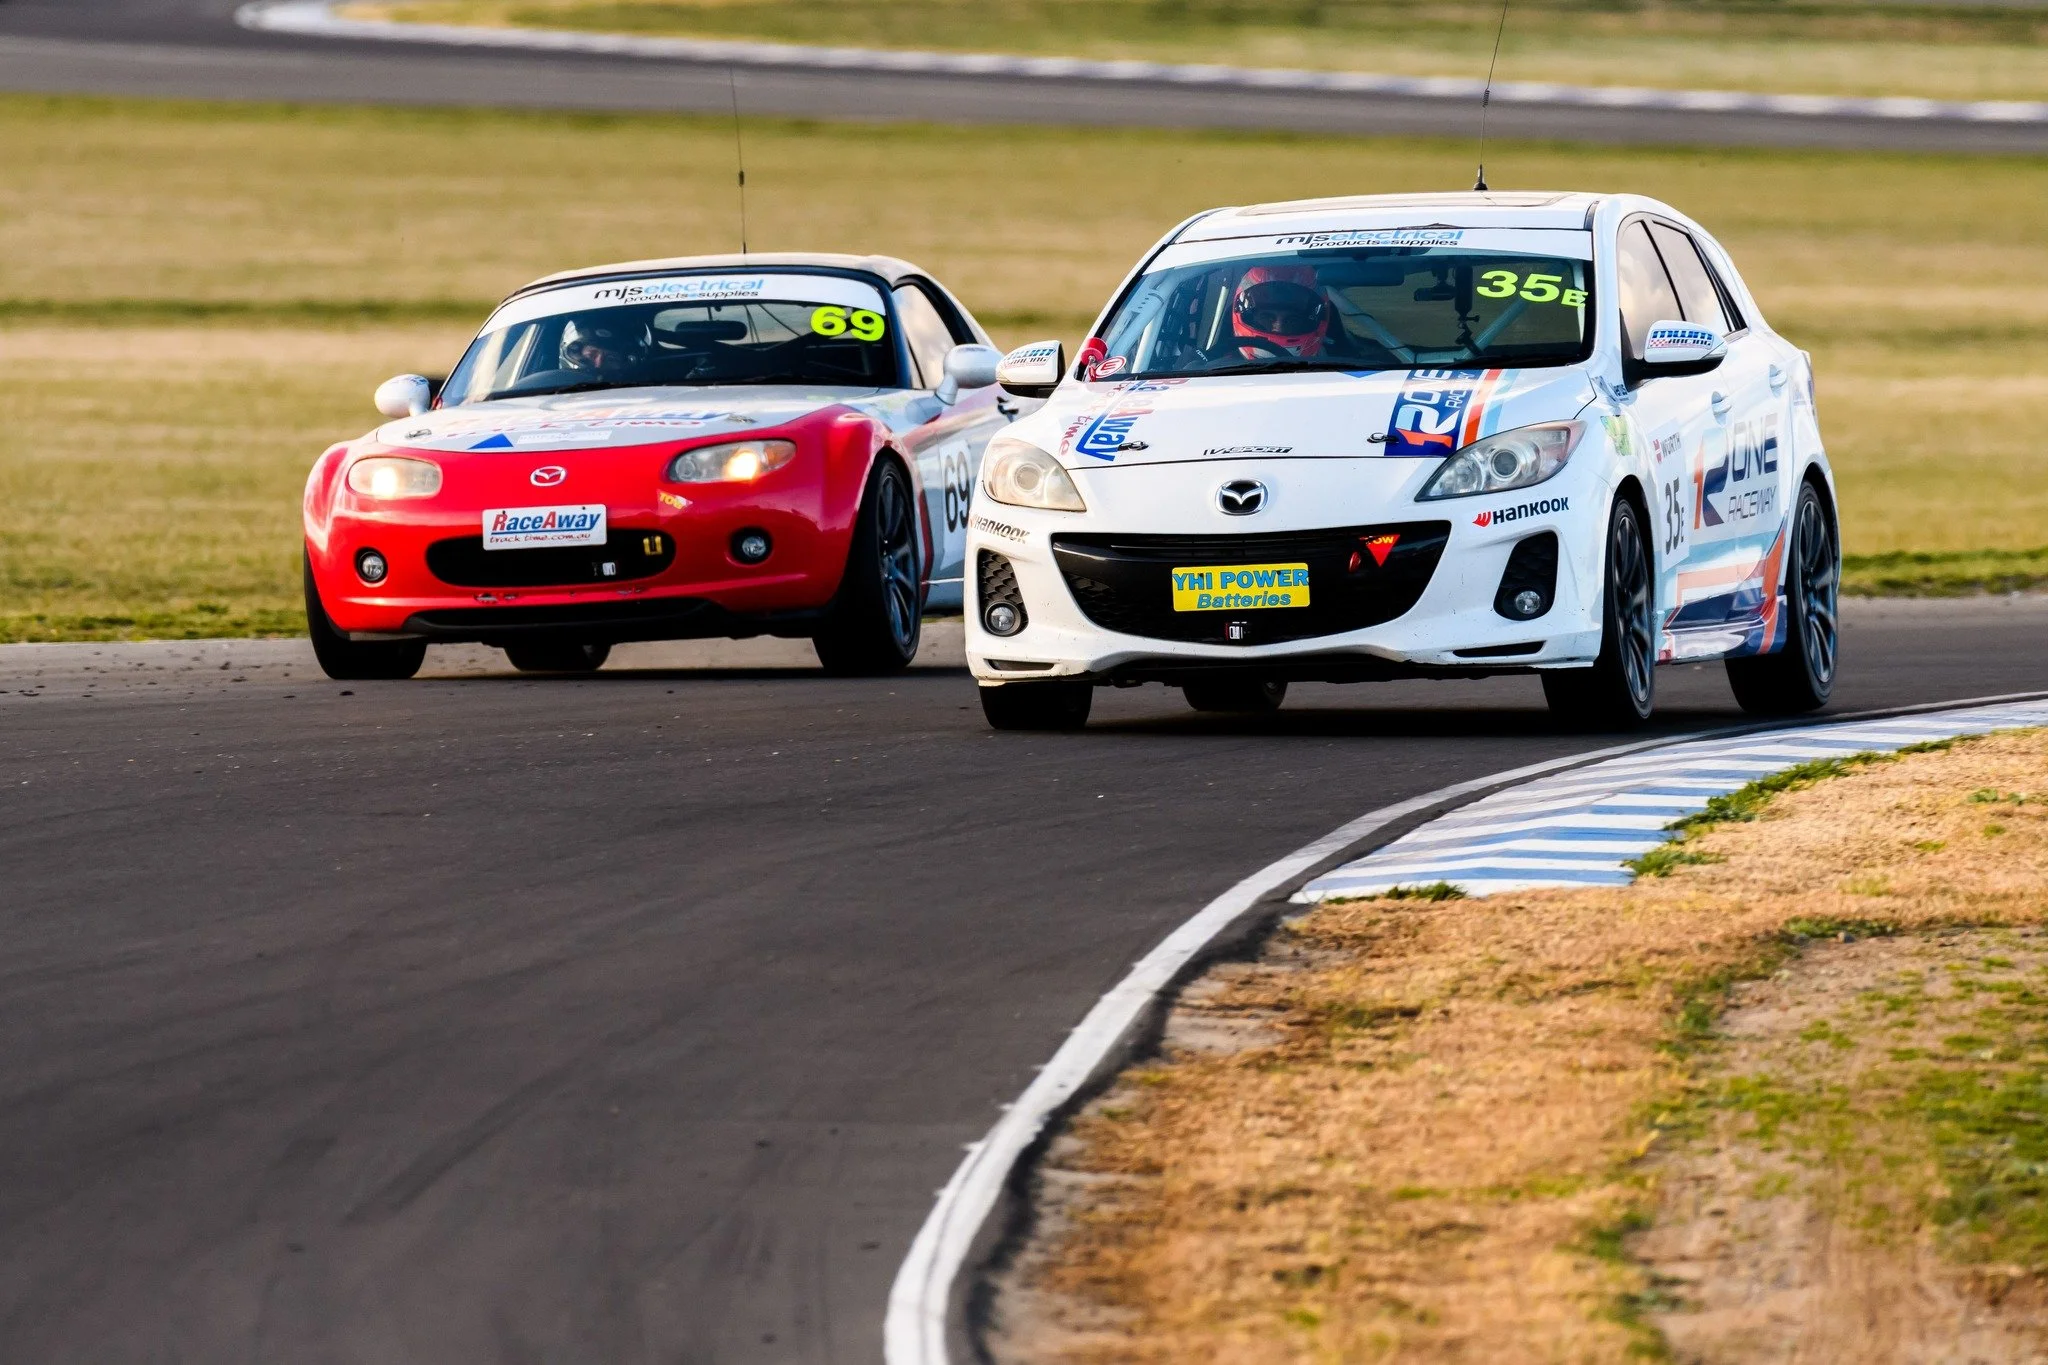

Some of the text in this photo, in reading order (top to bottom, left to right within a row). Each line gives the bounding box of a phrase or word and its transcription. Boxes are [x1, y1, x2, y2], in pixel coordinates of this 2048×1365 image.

[810, 305, 885, 342] 69
[944, 450, 971, 533] 69
[1727, 485, 1778, 523] RACEWAY
[491, 511, 602, 532] RaceAway
[1172, 568, 1309, 591] YHI POWER
[1197, 591, 1292, 609] Batteries
